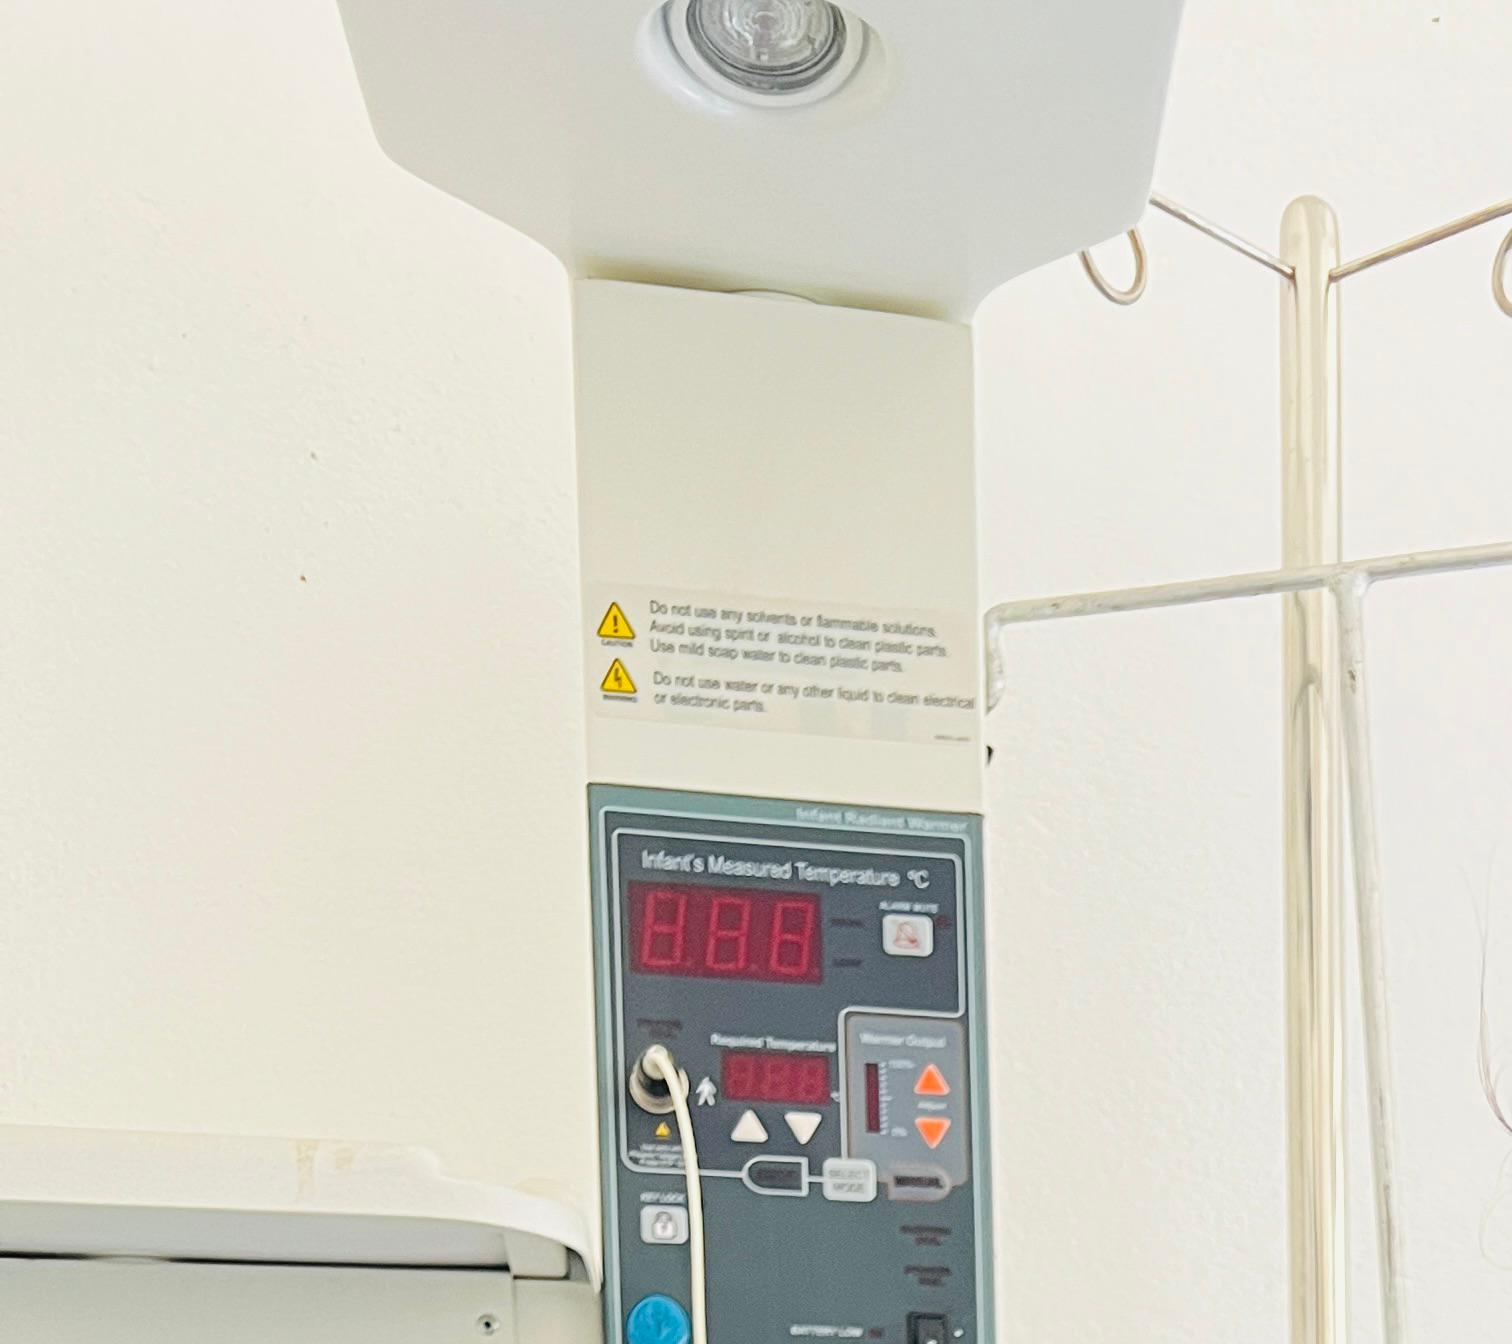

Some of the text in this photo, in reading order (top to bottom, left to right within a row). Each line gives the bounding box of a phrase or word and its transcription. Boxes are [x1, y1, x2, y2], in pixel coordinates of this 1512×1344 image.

[650, 601, 937, 638] Do not use any solvents or flammable solutions.
[650, 620, 948, 658] Avoid using spirit or alcohol to clean plastic parts.
[651, 640, 903, 672] Use mild soap water to clean plastic parts.
[653, 672, 974, 709] Do not use water or any other liquid to clean electrical
[654, 693, 667, 704] or
[670, 691, 729, 710] electronic
[733, 698, 765, 713] parts.
[797, 809, 968, 833] Infant Radiant Warmer
[642, 850, 704, 872] Infant's
[708, 855, 793, 879] Measured
[795, 861, 900, 886] Temperature
[710, 1032, 837, 1053] Required Temperature
